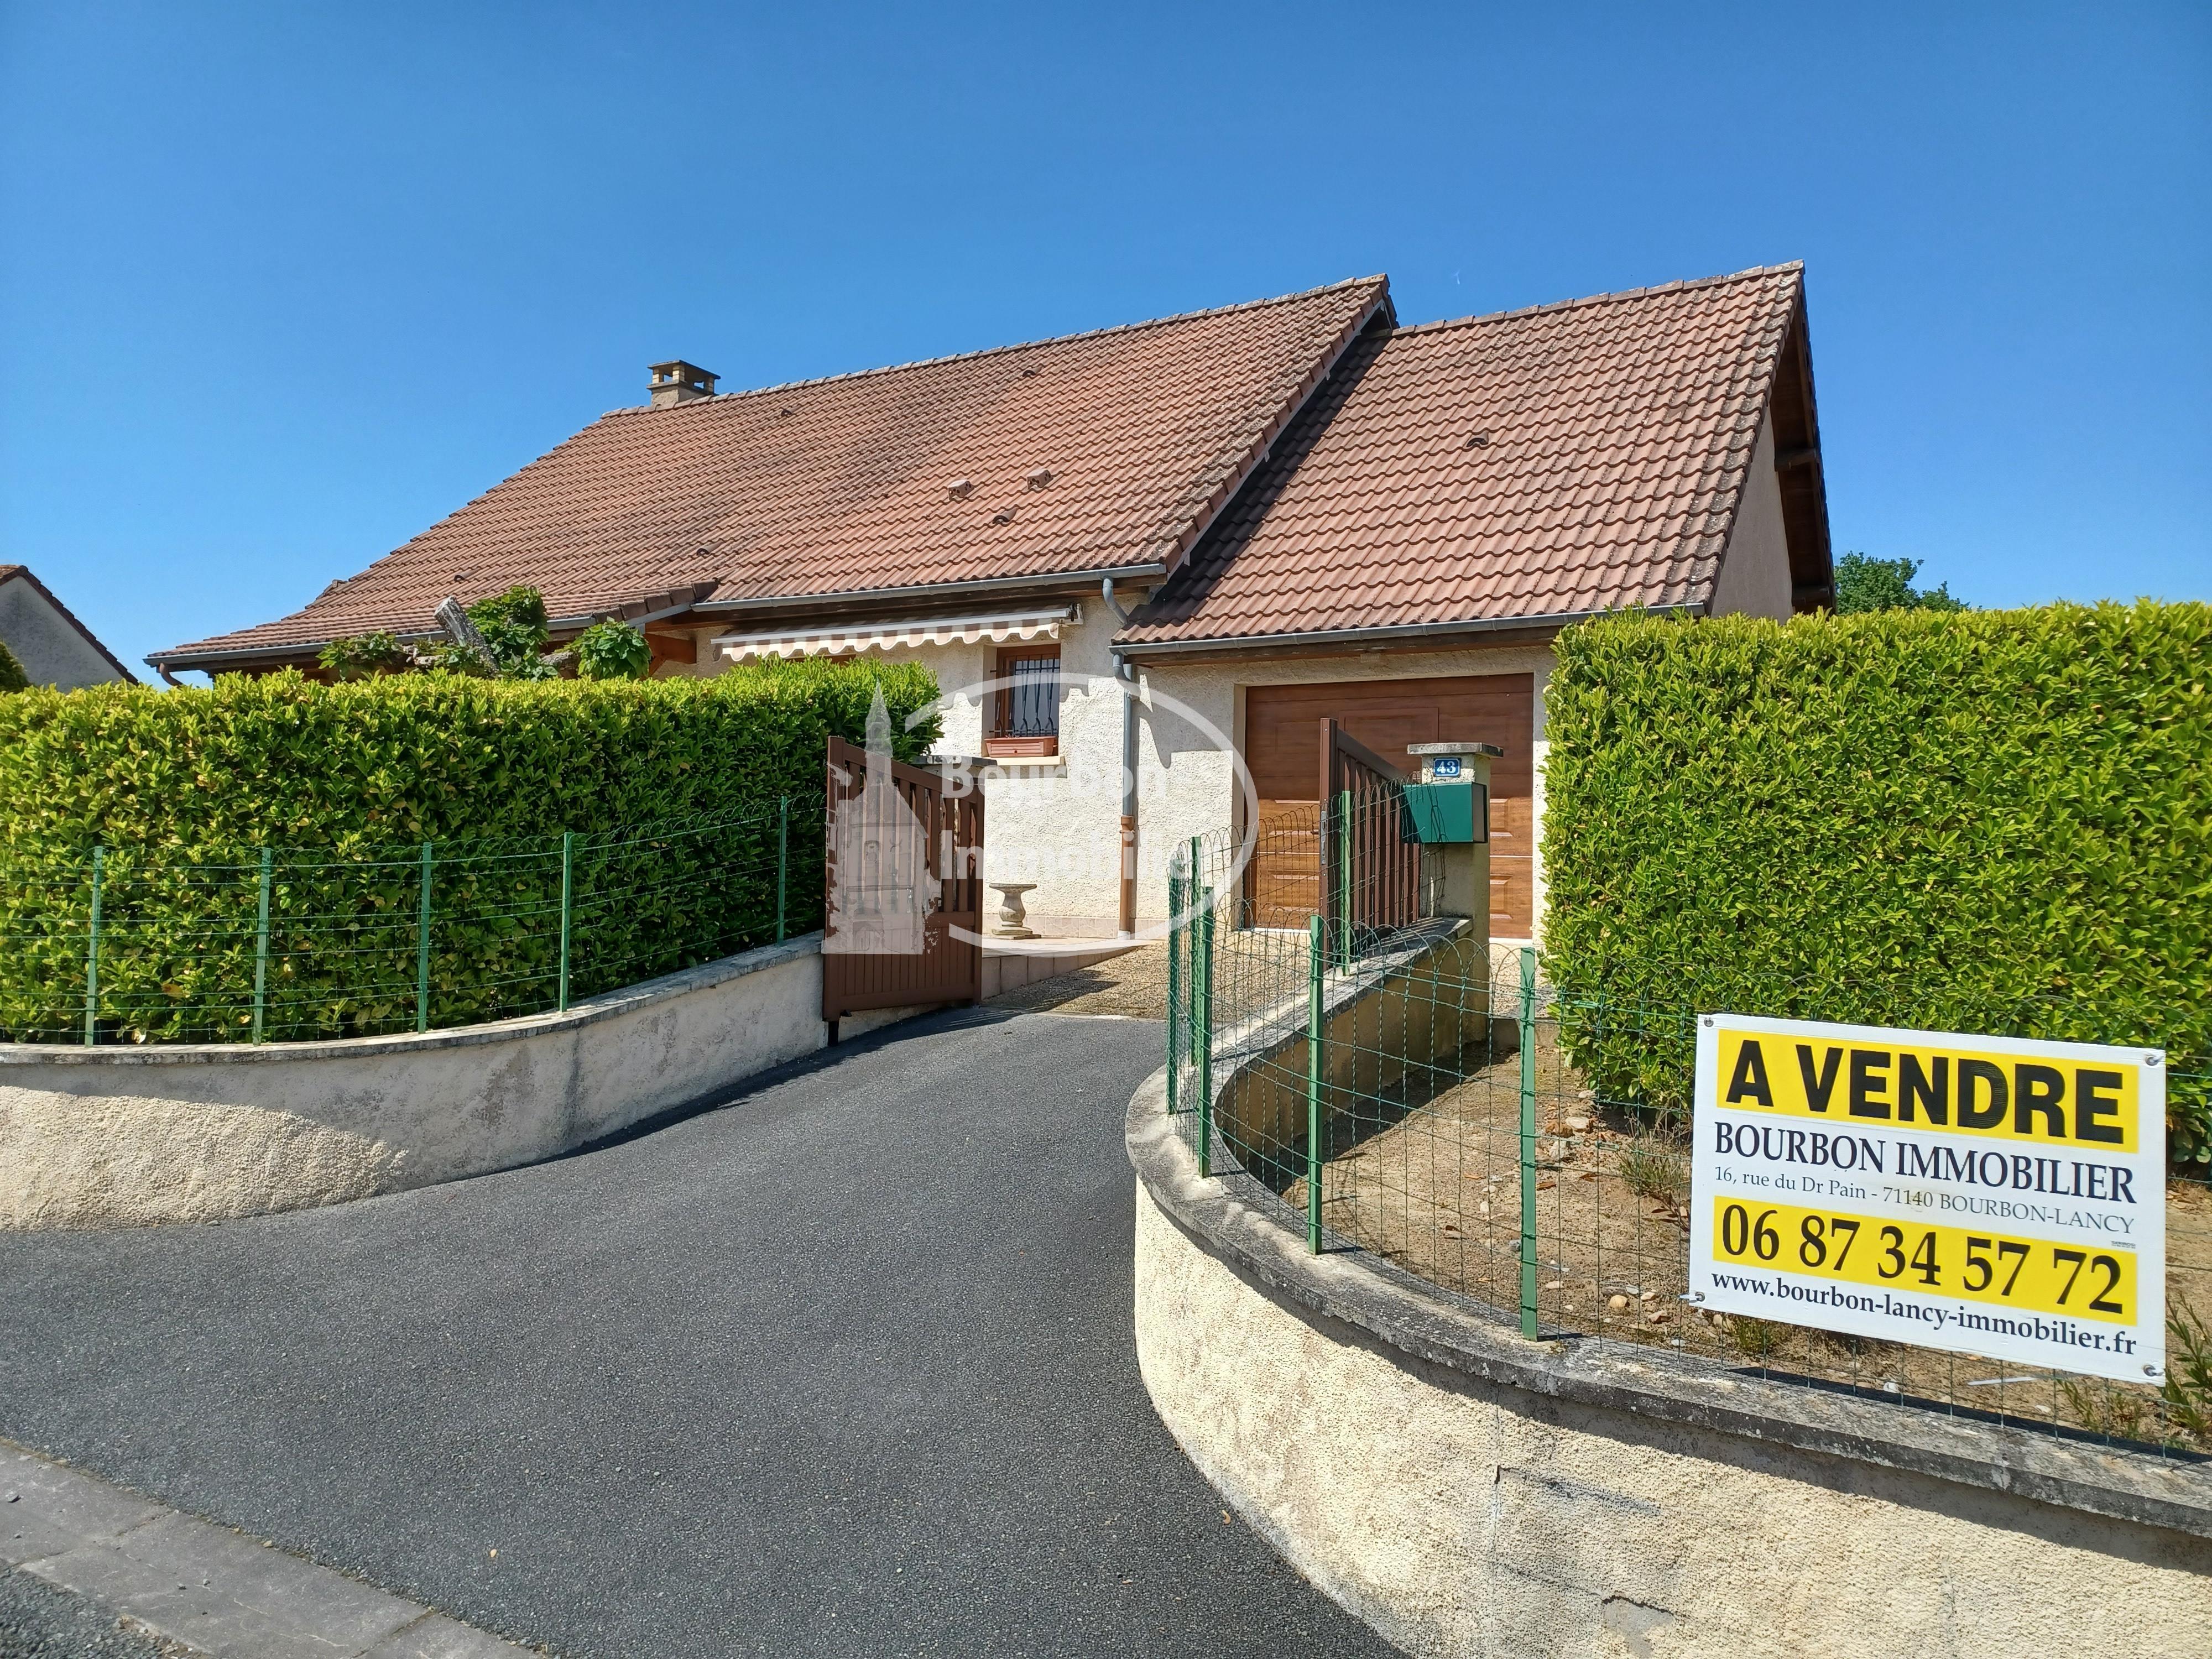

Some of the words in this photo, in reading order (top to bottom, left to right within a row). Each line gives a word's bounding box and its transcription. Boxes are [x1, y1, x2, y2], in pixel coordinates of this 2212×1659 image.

[1437, 761, 1457, 774] 43
[1725, 1039, 1774, 1107] A
[1795, 1044, 2124, 1144] VENDRE
[1714, 1121, 1886, 1173] BOURBON
[1895, 1141, 2137, 1204] IMMOBILIER
[1715, 1166, 1737, 1185] 16,
[1743, 1172, 1770, 1187] rue
[1775, 1173, 1797, 1191] du
[1802, 1177, 1824, 1194] Dr
[1828, 1180, 1866, 1199] Pain
[1883, 1187, 1933, 1207] 71140
[1940, 1193, 2135, 1234] BOURBON-LANCY
[1722, 1204, 1780, 1261] 06
[1799, 1215, 1861, 1271] 87
[1877, 1225, 1941, 1286] 34
[1963, 1236, 2031, 1296] 57
[2053, 1248, 2123, 1314] 72
[1711, 1272, 2137, 1355] www.bourbon-lancy-immobilier.fr
